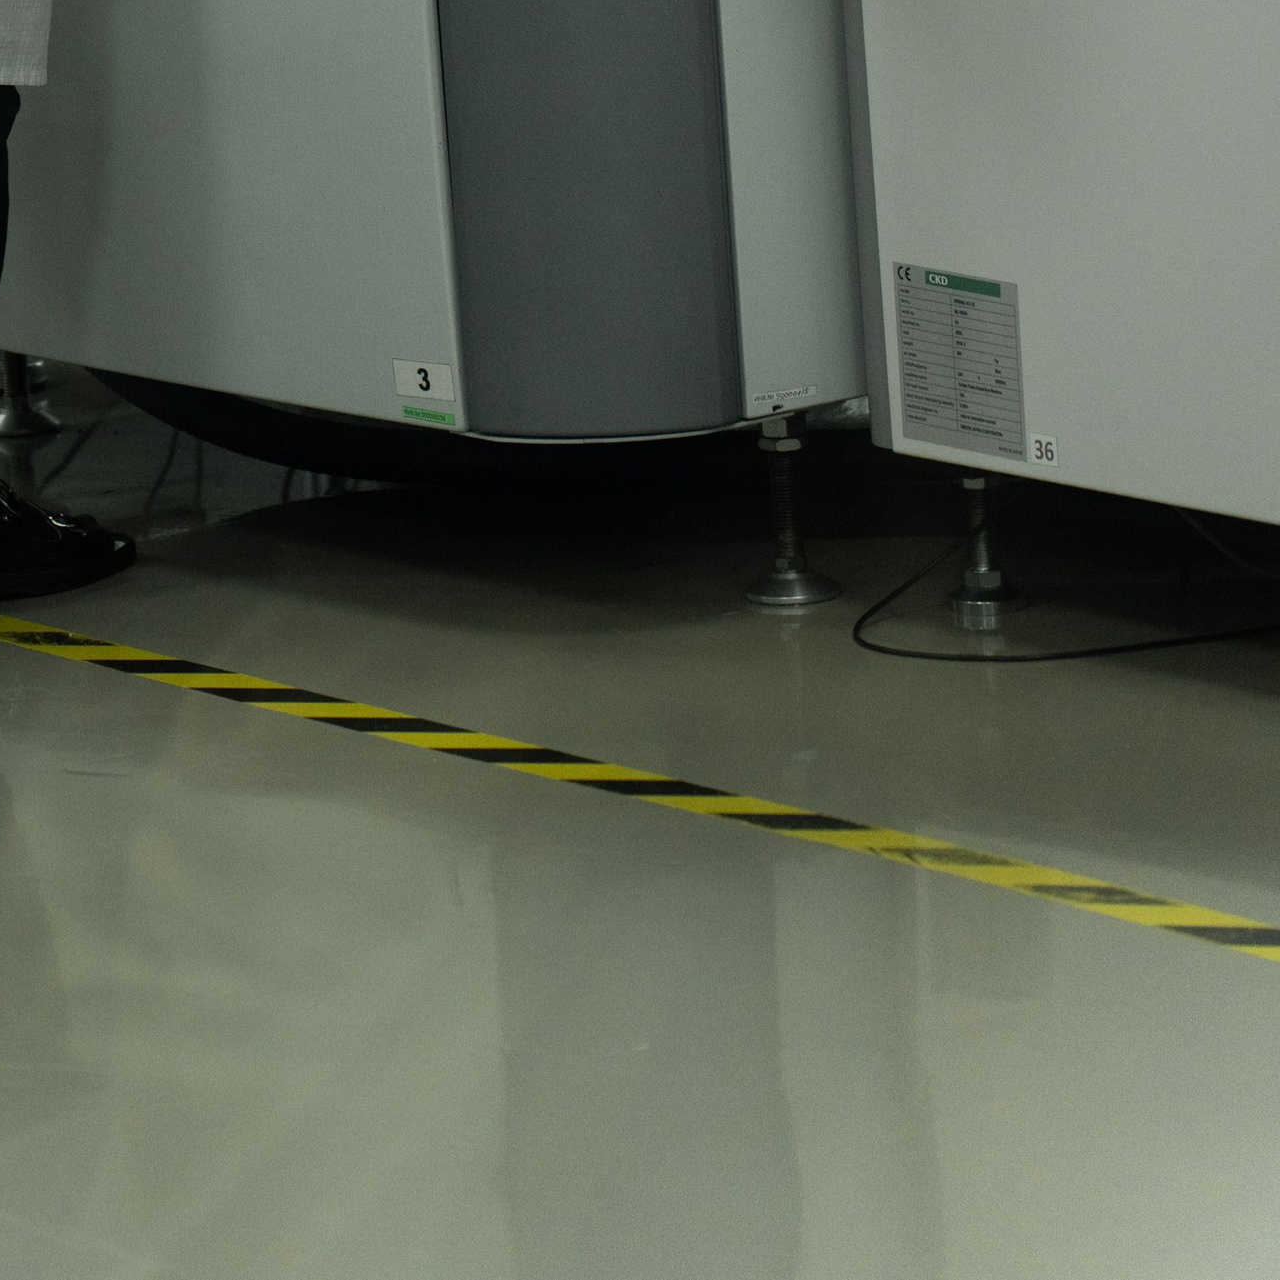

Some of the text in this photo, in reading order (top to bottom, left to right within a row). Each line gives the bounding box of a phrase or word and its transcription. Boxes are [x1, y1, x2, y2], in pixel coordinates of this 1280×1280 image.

[928, 273, 948, 287] CKD
[416, 367, 431, 392] 3
[1033, 439, 1055, 462] 36
